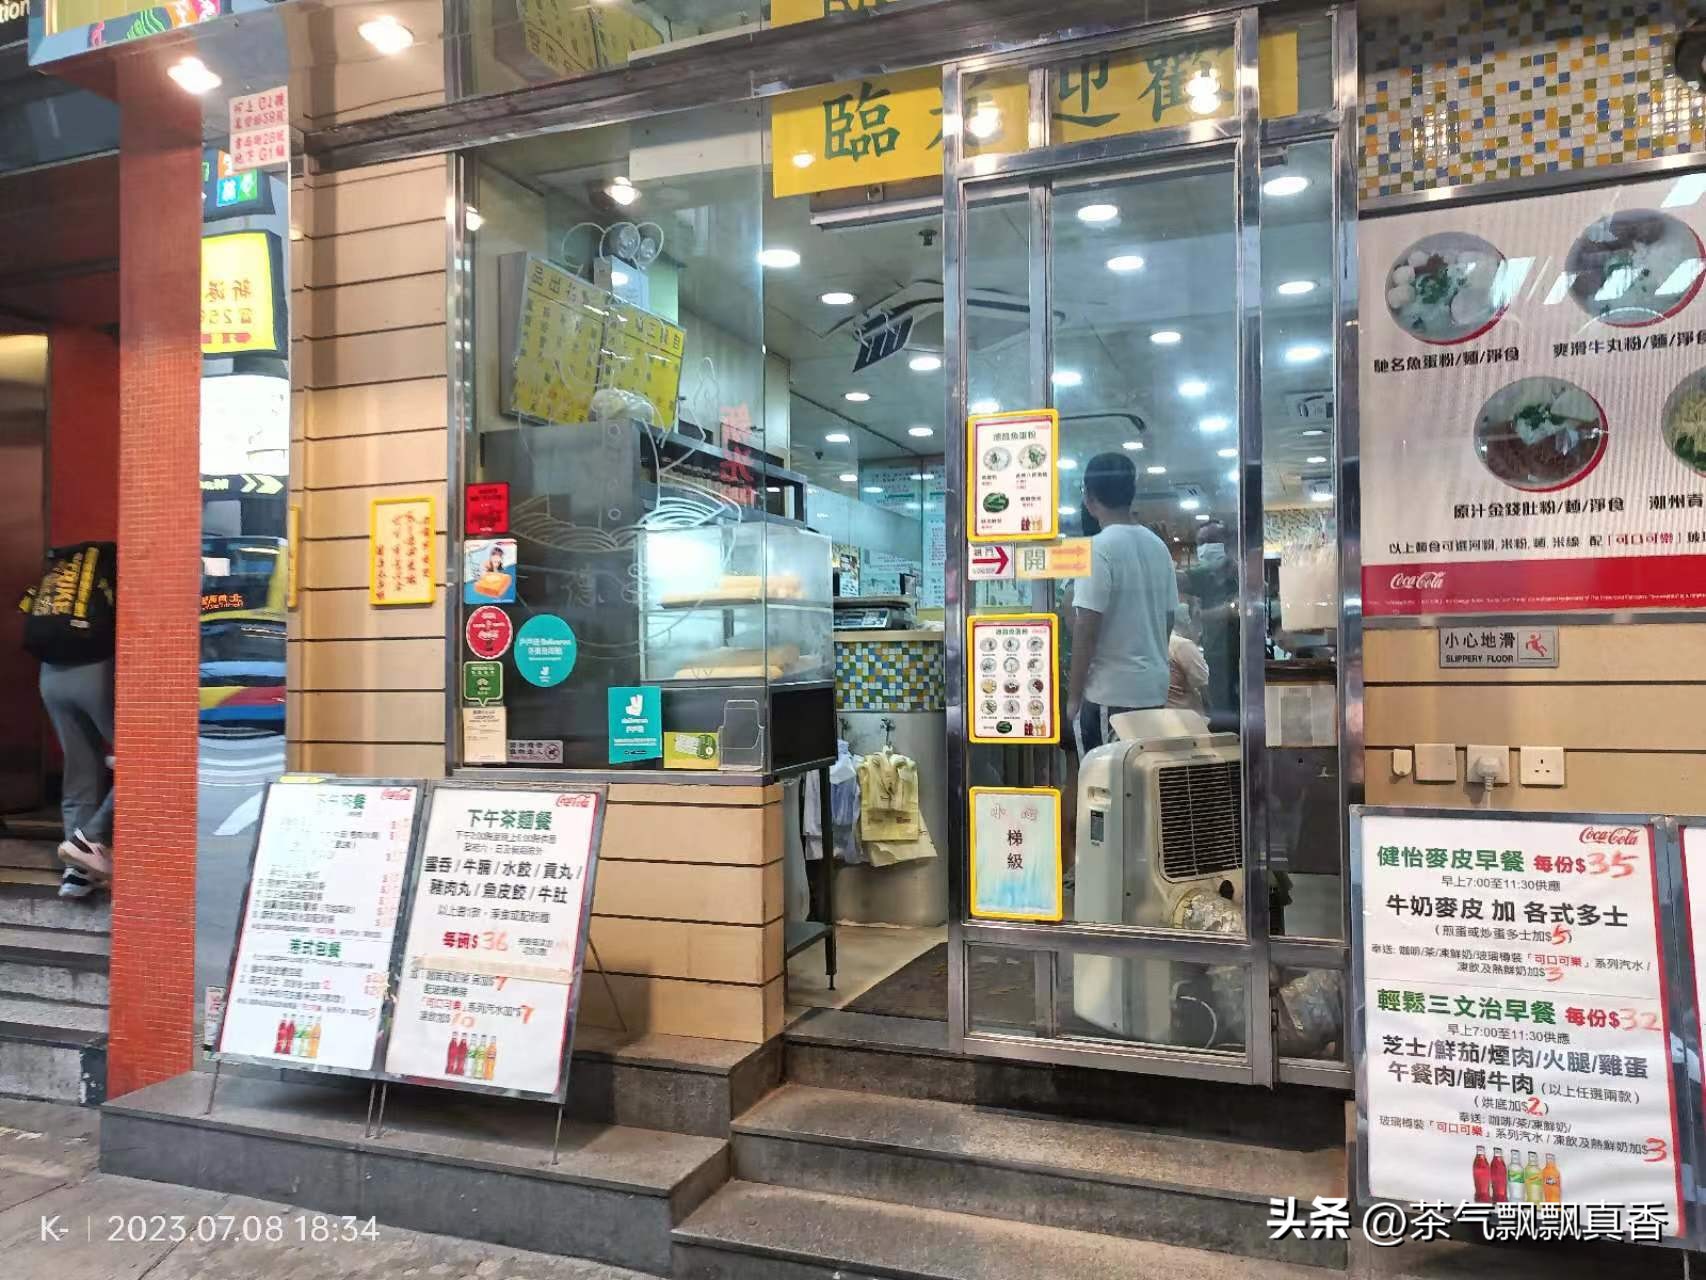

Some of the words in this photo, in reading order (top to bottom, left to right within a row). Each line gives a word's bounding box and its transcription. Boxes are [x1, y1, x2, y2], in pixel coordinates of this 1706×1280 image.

[1445, 632, 1516, 649] 小心地滑
[1445, 654, 1484, 663] SLIPPERY
[1487, 654, 1514, 663] FLOOR
[1579, 826, 1639, 845] Coca-Cola
[1007, 829, 1023, 870] 梯級
[1377, 846, 1526, 873] 健怡麥皮早餐
[1441, 875, 1561, 892] 早上7:00至11:30供應
[1386, 894, 1484, 920] 牛奶麥皮
[1492, 900, 1515, 922] 加
[1524, 902, 1628, 928] 各式多士
[1377, 988, 1557, 1025] 輕鬆三文治早餐
